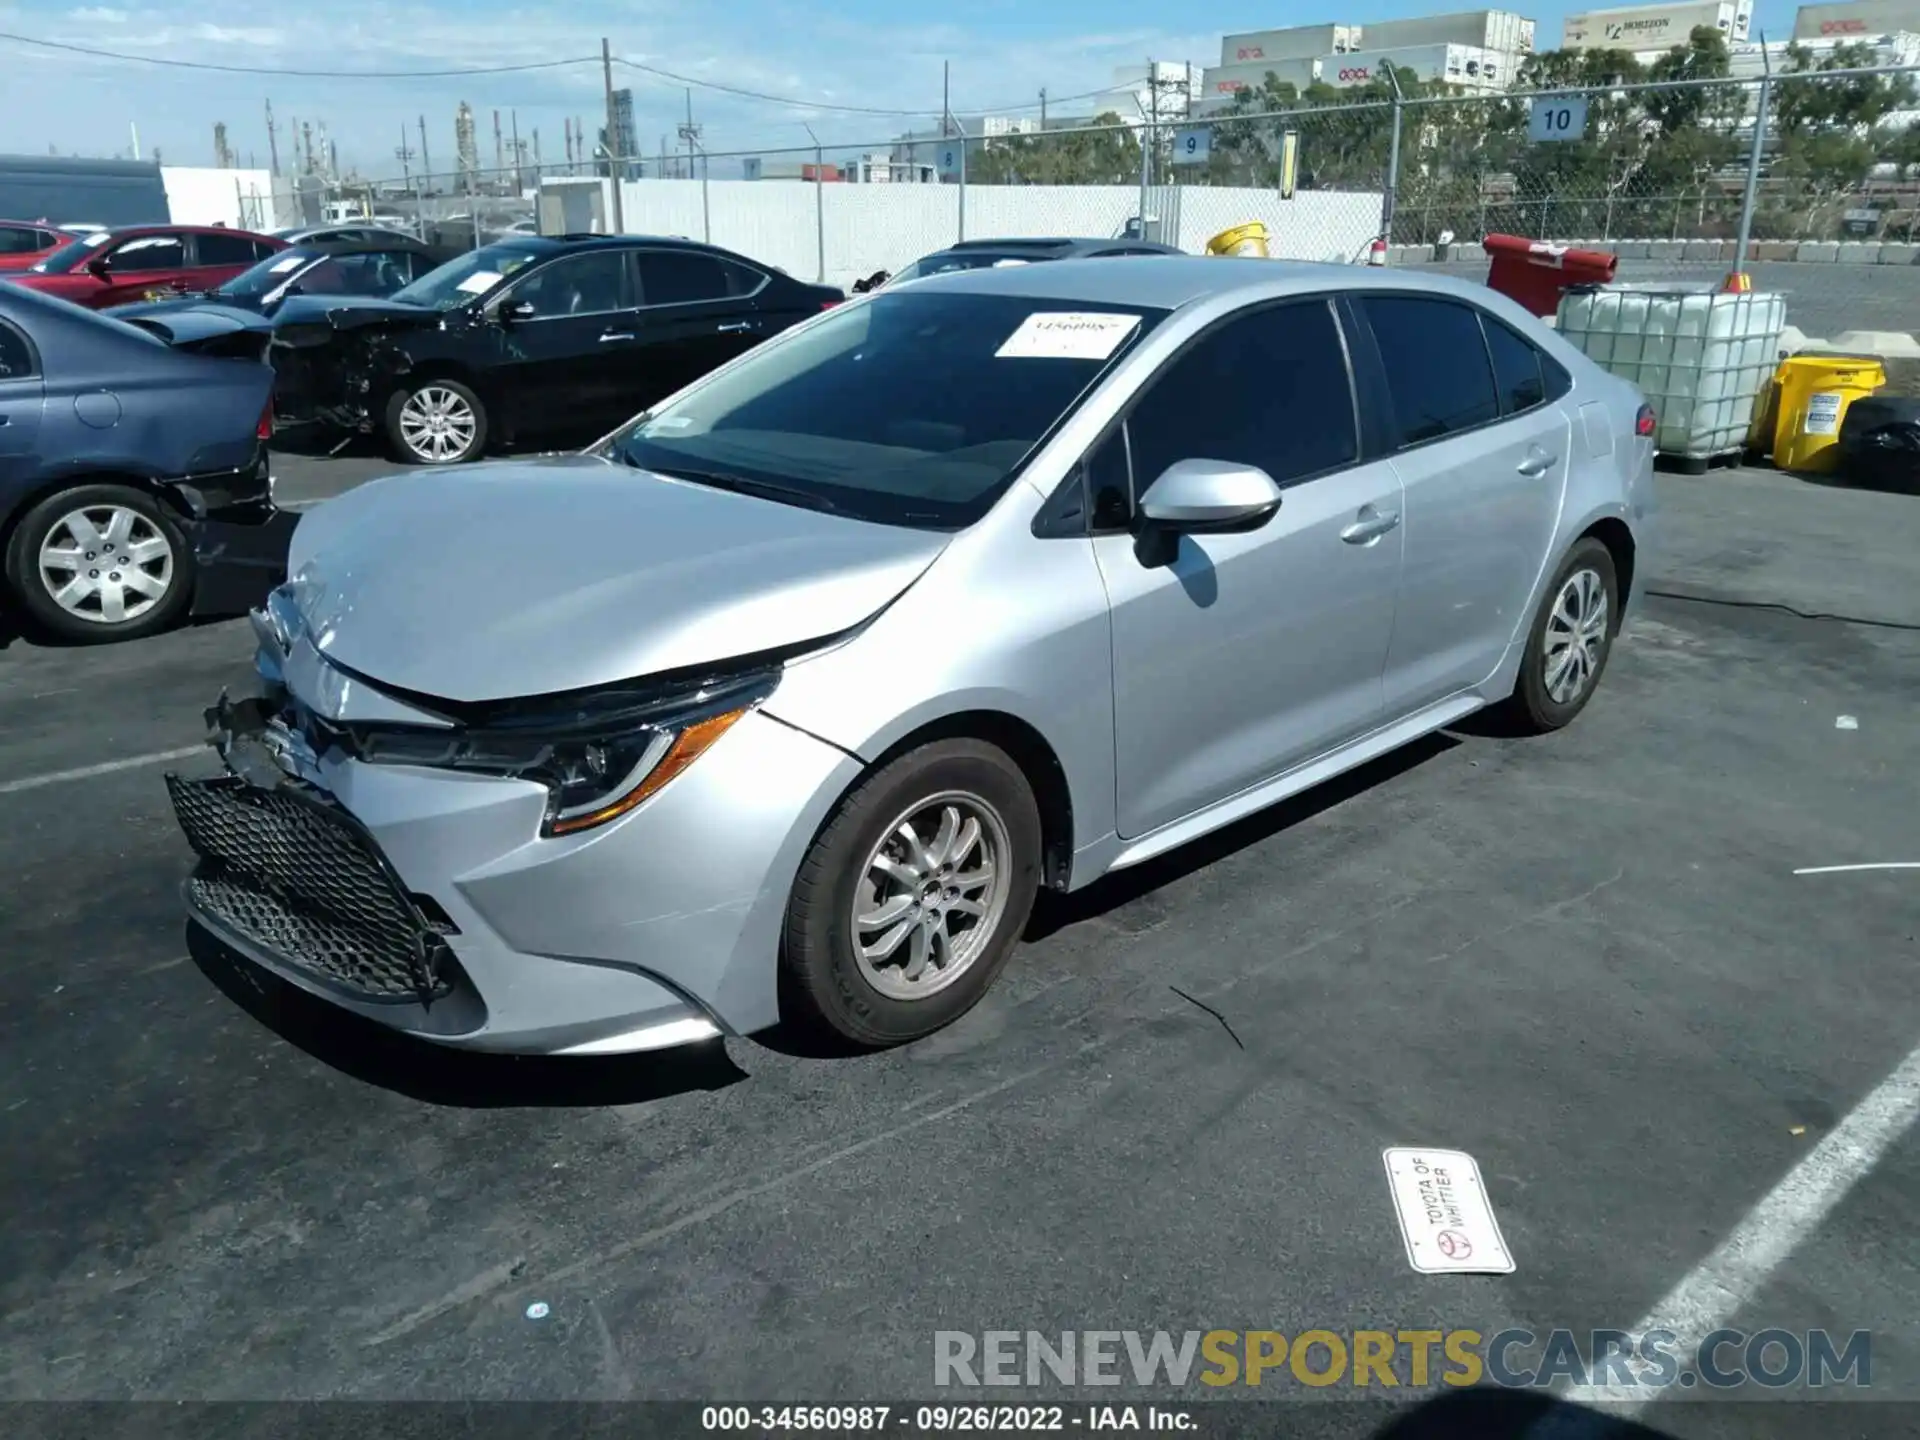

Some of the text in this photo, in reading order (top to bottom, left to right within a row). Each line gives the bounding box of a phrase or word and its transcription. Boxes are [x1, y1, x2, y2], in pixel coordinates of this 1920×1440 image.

[1623, 18, 1671, 30] HORIZON
[1544, 109, 1571, 130] 10
[1186, 136, 1196, 154] 9
[1412, 1157, 1444, 1225] TOYOTA OF
[1433, 1167, 1464, 1228] WHITTIER
